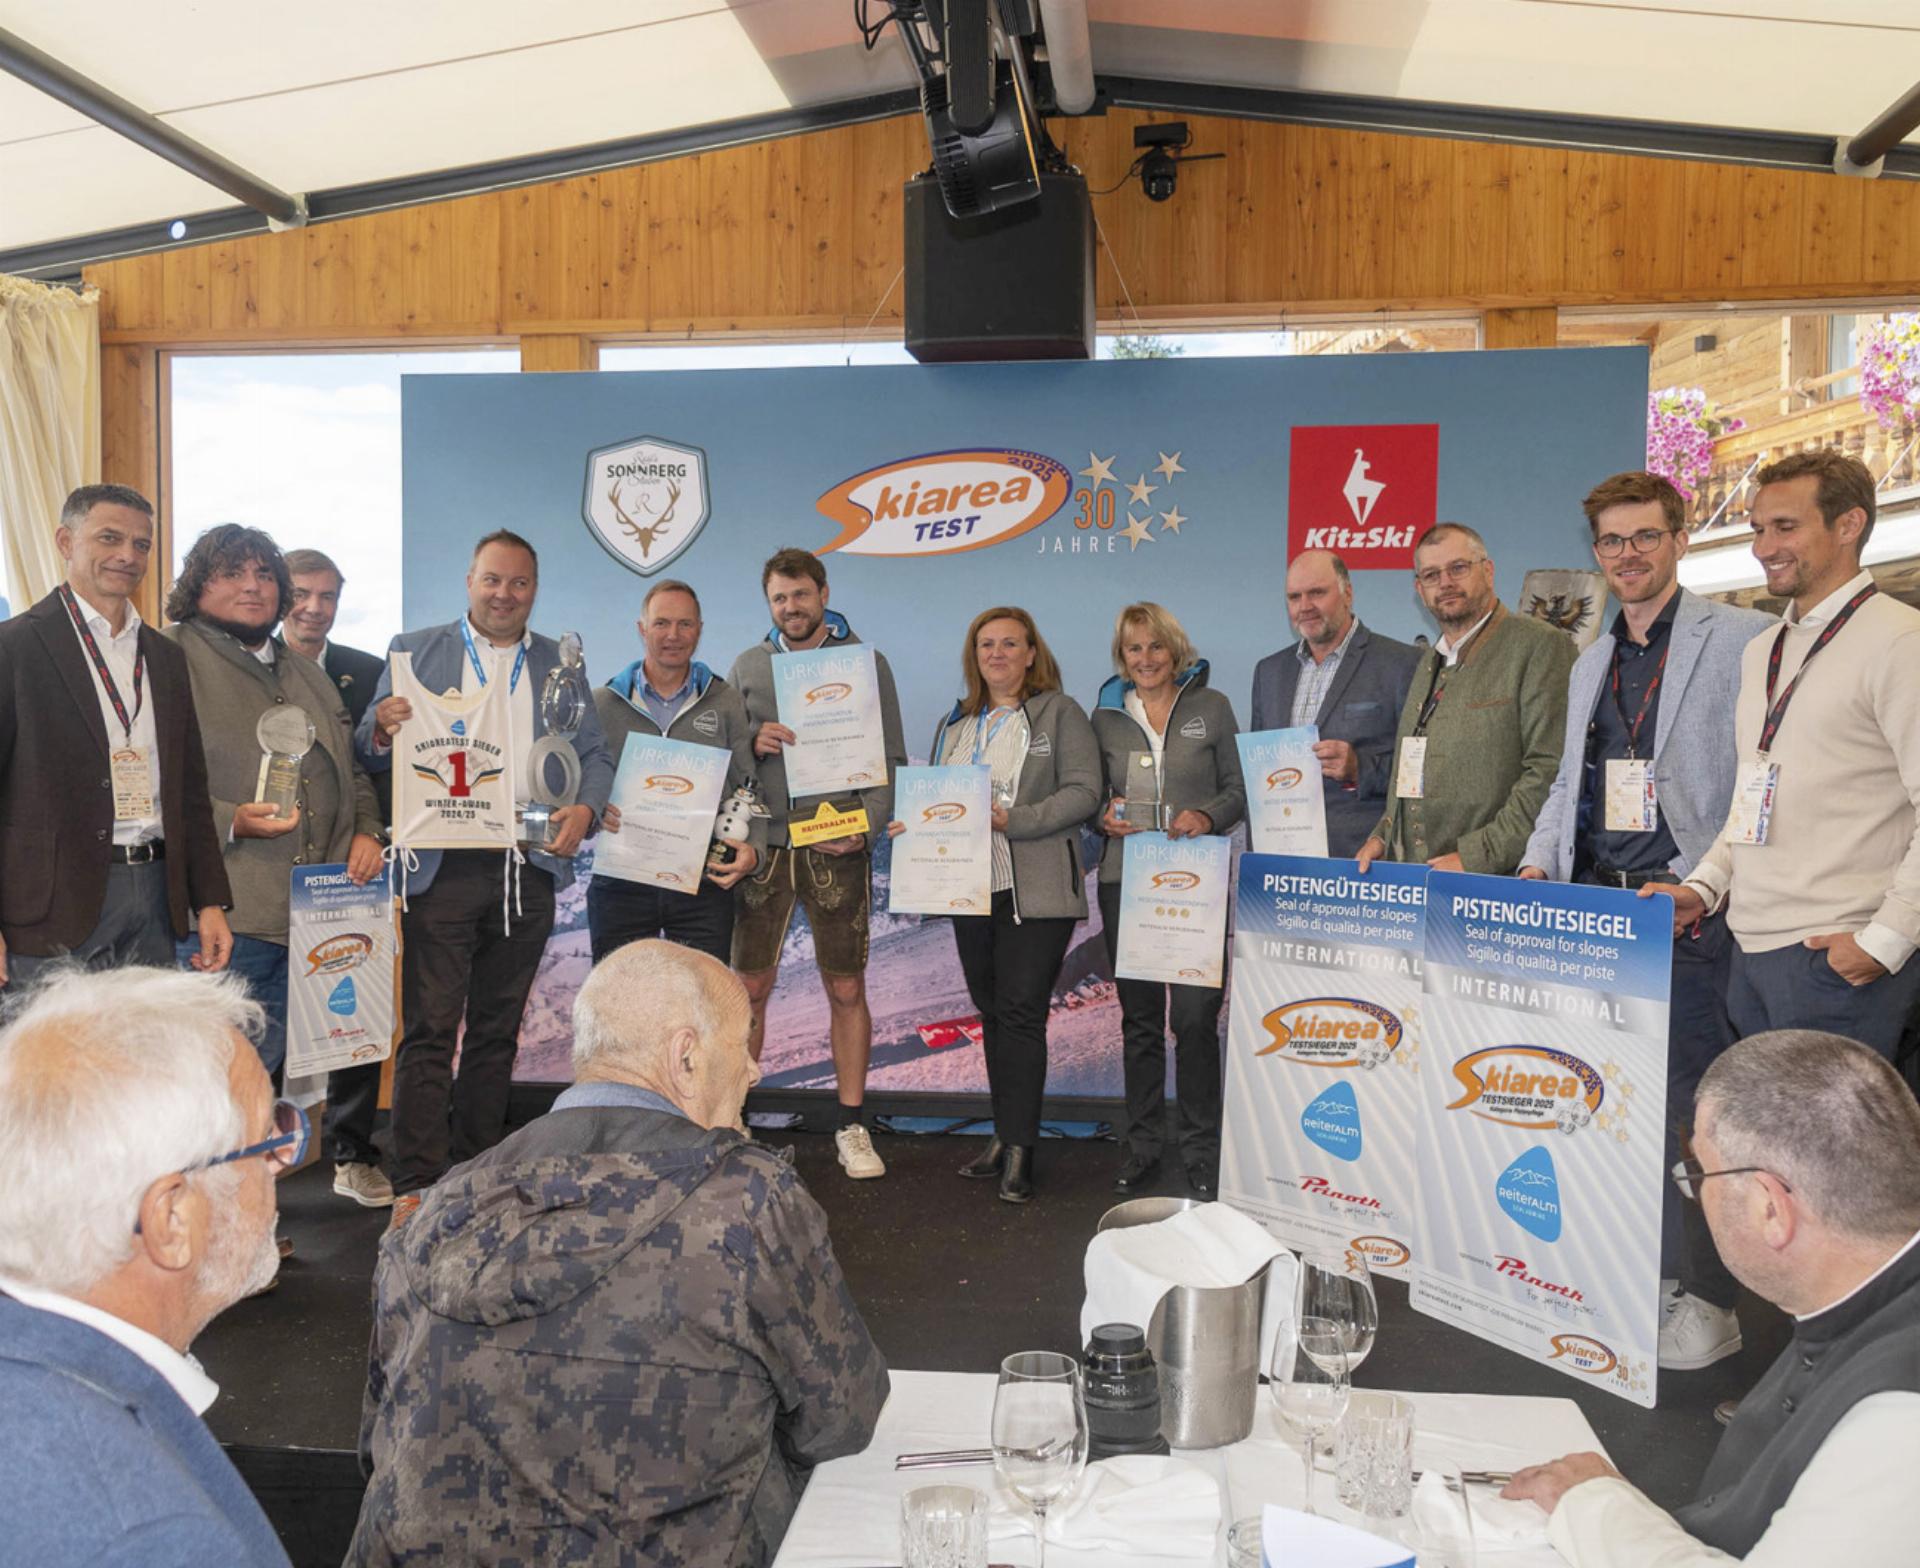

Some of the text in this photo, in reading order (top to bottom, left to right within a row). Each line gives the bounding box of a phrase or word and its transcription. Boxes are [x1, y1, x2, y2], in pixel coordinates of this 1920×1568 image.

[607, 464, 687, 478] SONNBERG
[1007, 456, 1053, 483] 2025
[1074, 488, 1116, 529] 30
[914, 516, 981, 542] TEST
[1304, 525, 1416, 549] KitzSki
[1038, 535, 1116, 553] JAHRE
[783, 656, 865, 680] URKUNDE
[448, 751, 470, 797] 1
[632, 746, 717, 776] URKUNDE
[905, 778, 981, 796] URKUNDE
[1134, 843, 1218, 865] URKUNDE
[1276, 897, 1418, 924] Seal of approval for slopes
[1453, 896, 1637, 940] PISTENGÜTESIEGEL
[1277, 914, 1415, 942] Sigillo di qualità per piste
[1465, 923, 1619, 960] Seal of approval for slopes
[1263, 940, 1424, 976] INTERNATIONAL
[1467, 944, 1615, 981] Sigillo di qualità per piste
[1453, 975, 1626, 1024] INTERNATIONAL
[1289, 1040, 1357, 1050] TESTSIEGER 2025
[1481, 1094, 1555, 1109] TESTSIEGER 2025
[1299, 1176, 1381, 1209] Prinoth
[1494, 1255, 1584, 1303] Prinoth
[1574, 1357, 1593, 1368] TEST
